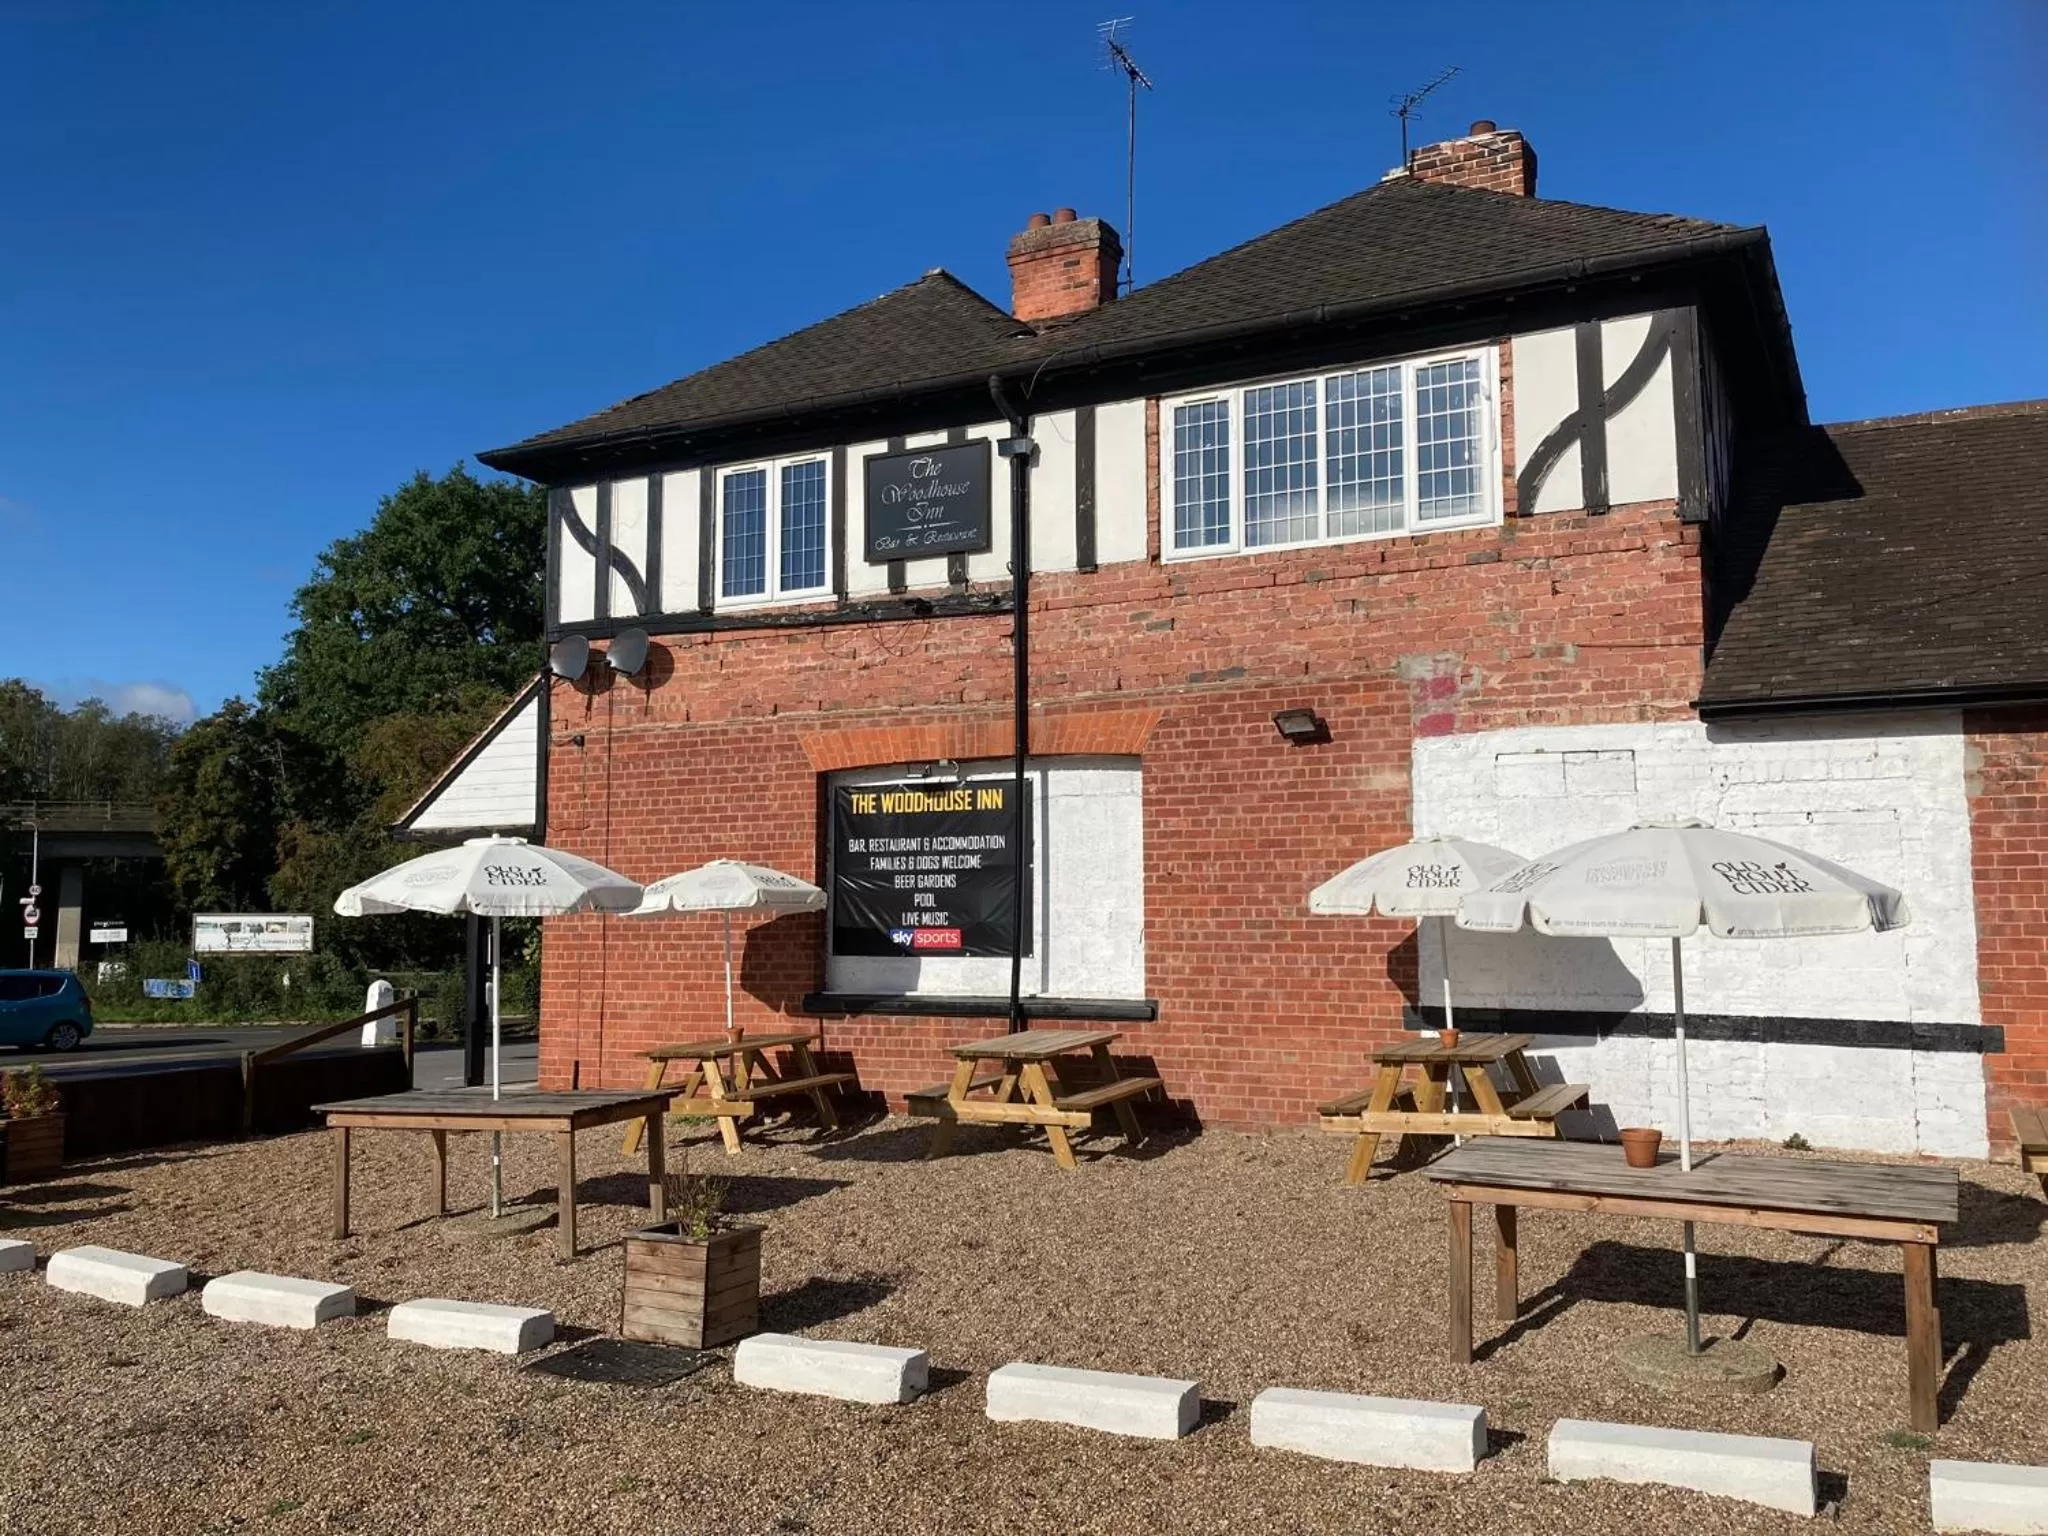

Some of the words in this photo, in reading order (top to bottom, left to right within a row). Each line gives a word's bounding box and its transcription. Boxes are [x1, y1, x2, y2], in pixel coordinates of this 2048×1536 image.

[908, 457, 942, 479] The
[881, 479, 970, 504] Woodhouse
[906, 501, 944, 522] Inn
[875, 536, 900, 551] Bar
[905, 533, 919, 547] &
[851, 793, 876, 814] THE
[881, 789, 973, 813] WOODHOUSE
[977, 788, 1003, 810] INN
[869, 837, 921, 852] RESTAURANT
[924, 837, 930, 851] &
[932, 835, 1006, 850] ACCOMMODATION
[870, 856, 906, 871] FAMILIES
[908, 856, 915, 870] &
[916, 855, 940, 870] DOGS
[941, 854, 982, 870] WELCOME
[1407, 864, 1442, 873] OLD
[1711, 861, 1762, 873] OLD
[488, 871, 543, 879] MOUT
[894, 874, 916, 889] BEER
[917, 873, 957, 889] GARDENS
[1408, 870, 1461, 880] MOUT
[1722, 869, 1800, 882] MOUT
[1406, 878, 1461, 888] CIDER
[1732, 880, 1817, 894] CIDER
[914, 893, 937, 907] POOL
[902, 911, 920, 926] LIVE
[921, 911, 949, 926] MUSIC
[892, 930, 913, 946] sky
[916, 932, 958, 945] sports
